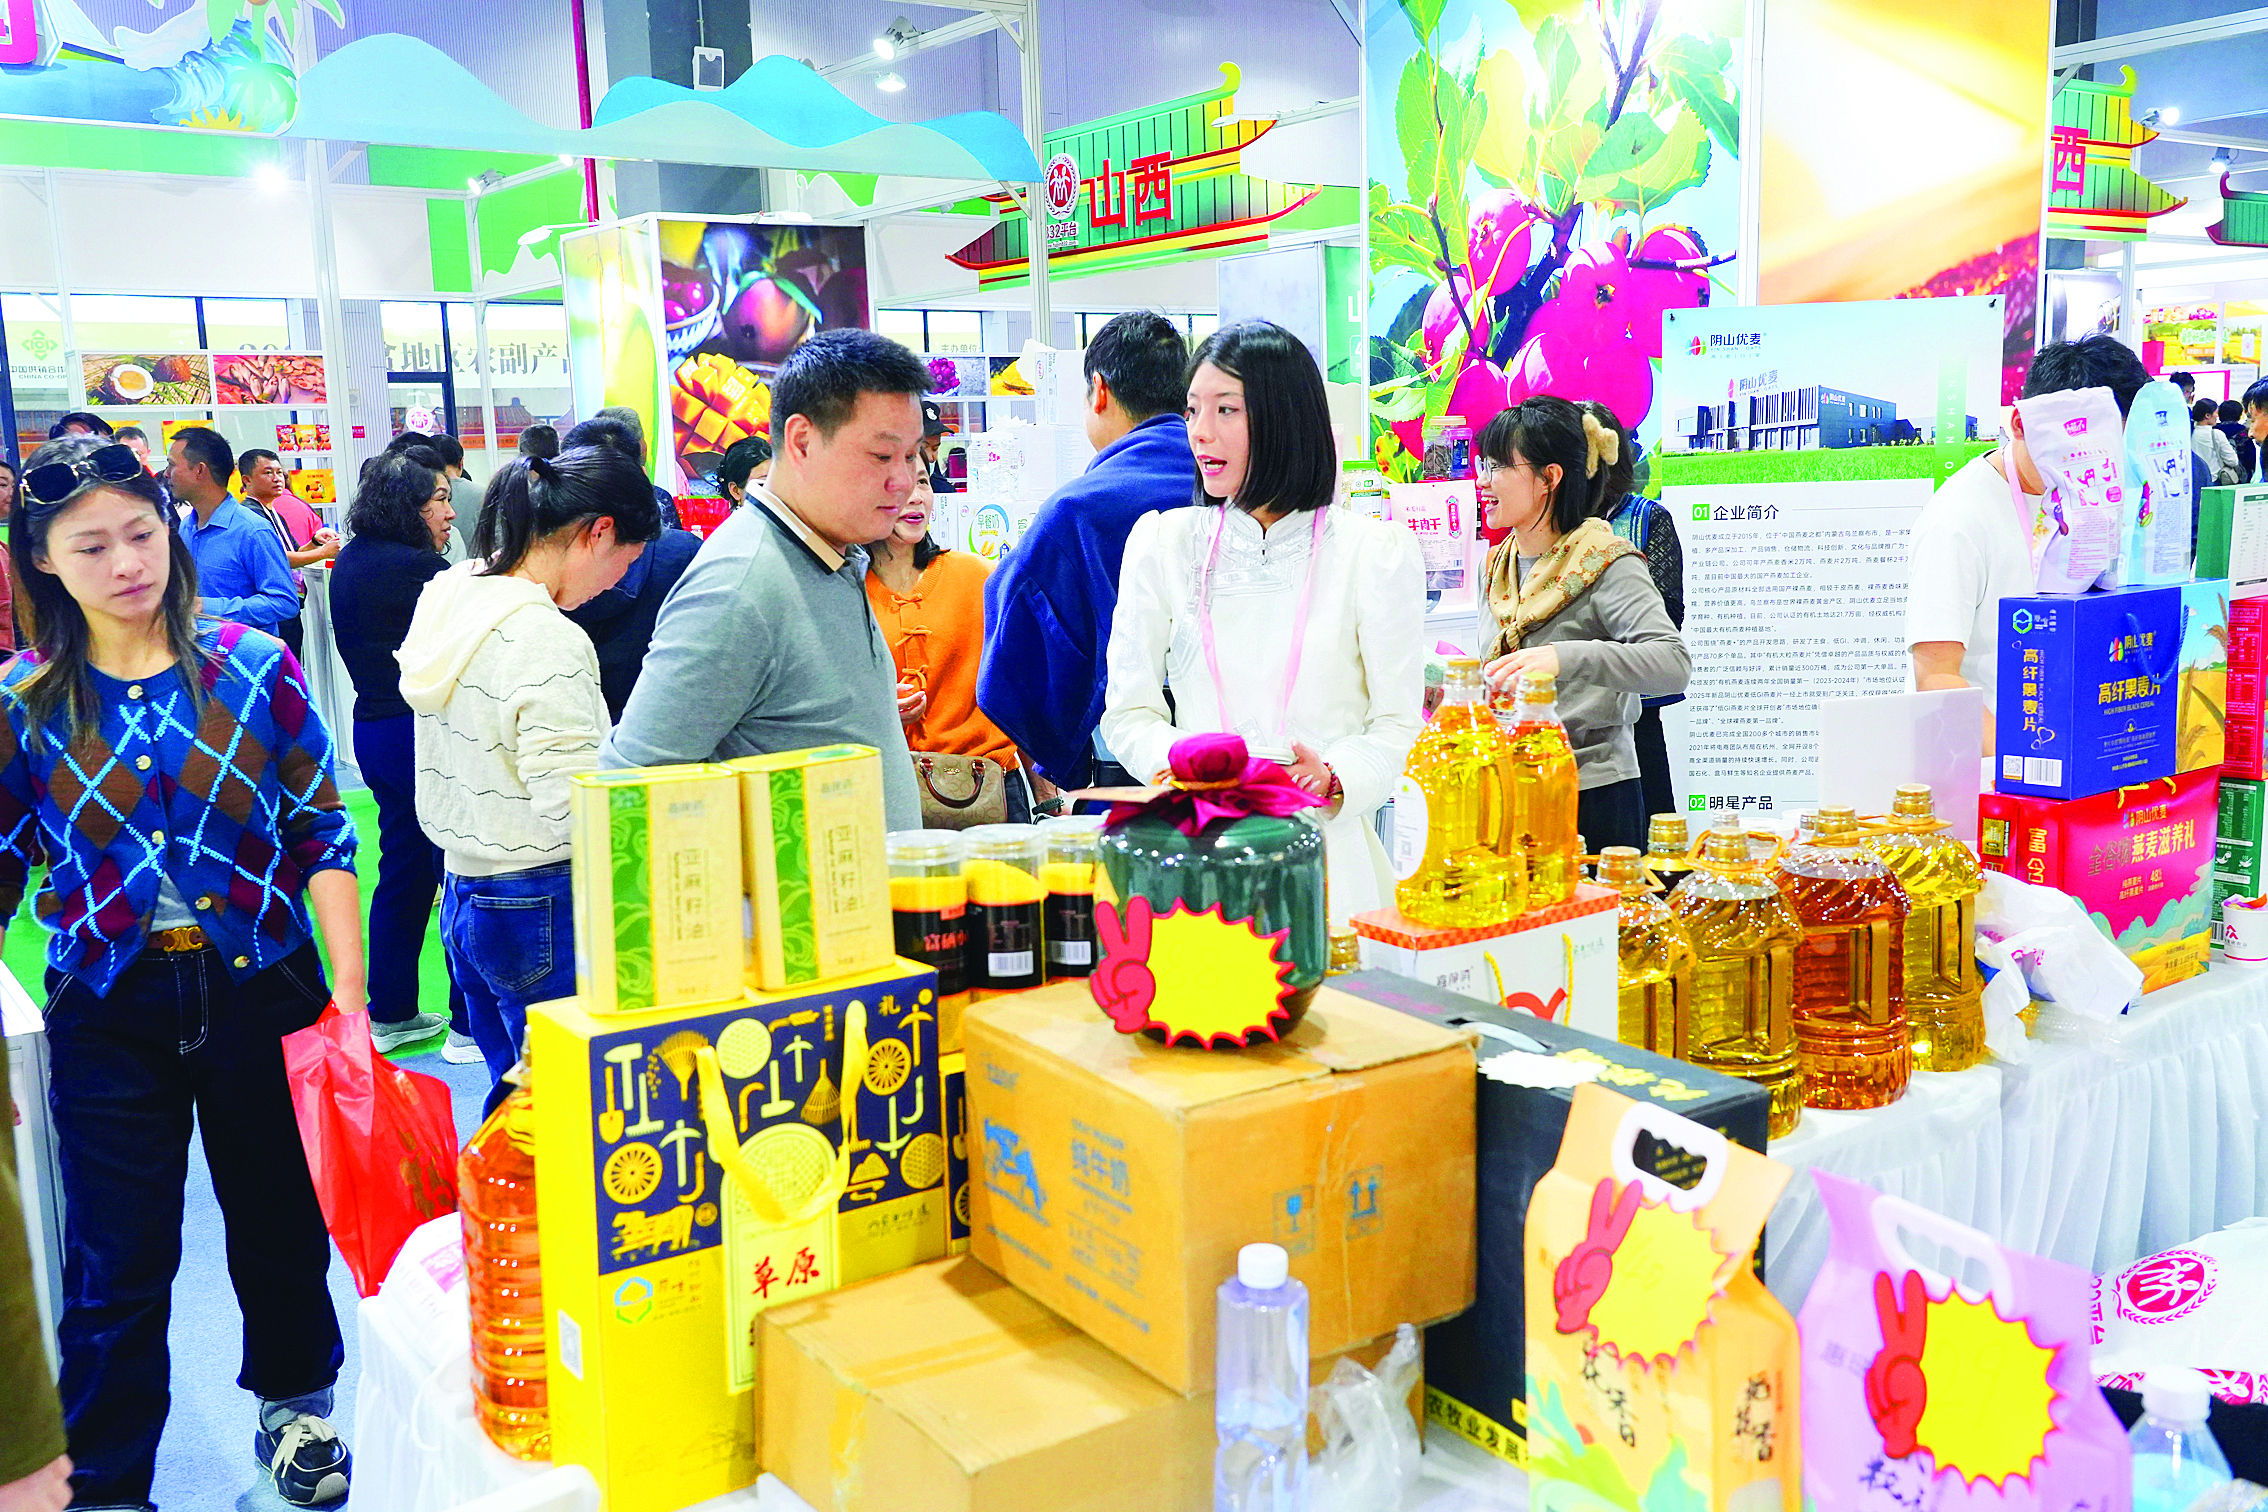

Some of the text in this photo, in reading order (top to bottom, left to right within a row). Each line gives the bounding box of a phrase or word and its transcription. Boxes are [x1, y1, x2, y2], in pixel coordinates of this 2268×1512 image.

[2053, 125, 2087, 195] 西
[1089, 151, 1174, 228] 山西
[1710, 332, 1761, 347] 阴山优麦
[1739, 369, 1778, 392] 阴山优麦
[1693, 504, 1779, 521] 01 企业简介
[1408, 518, 1441, 531] 牛肉干
[2022, 648, 2039, 732] 高纤黑麦片
[2098, 673, 2161, 705] 高纤黑麦片
[1690, 796, 1773, 810] 02 明星产品
[2136, 804, 2167, 826] 阴山优麦
[878, 994, 902, 1017] 礼
[751, 1246, 820, 1299] 草原
